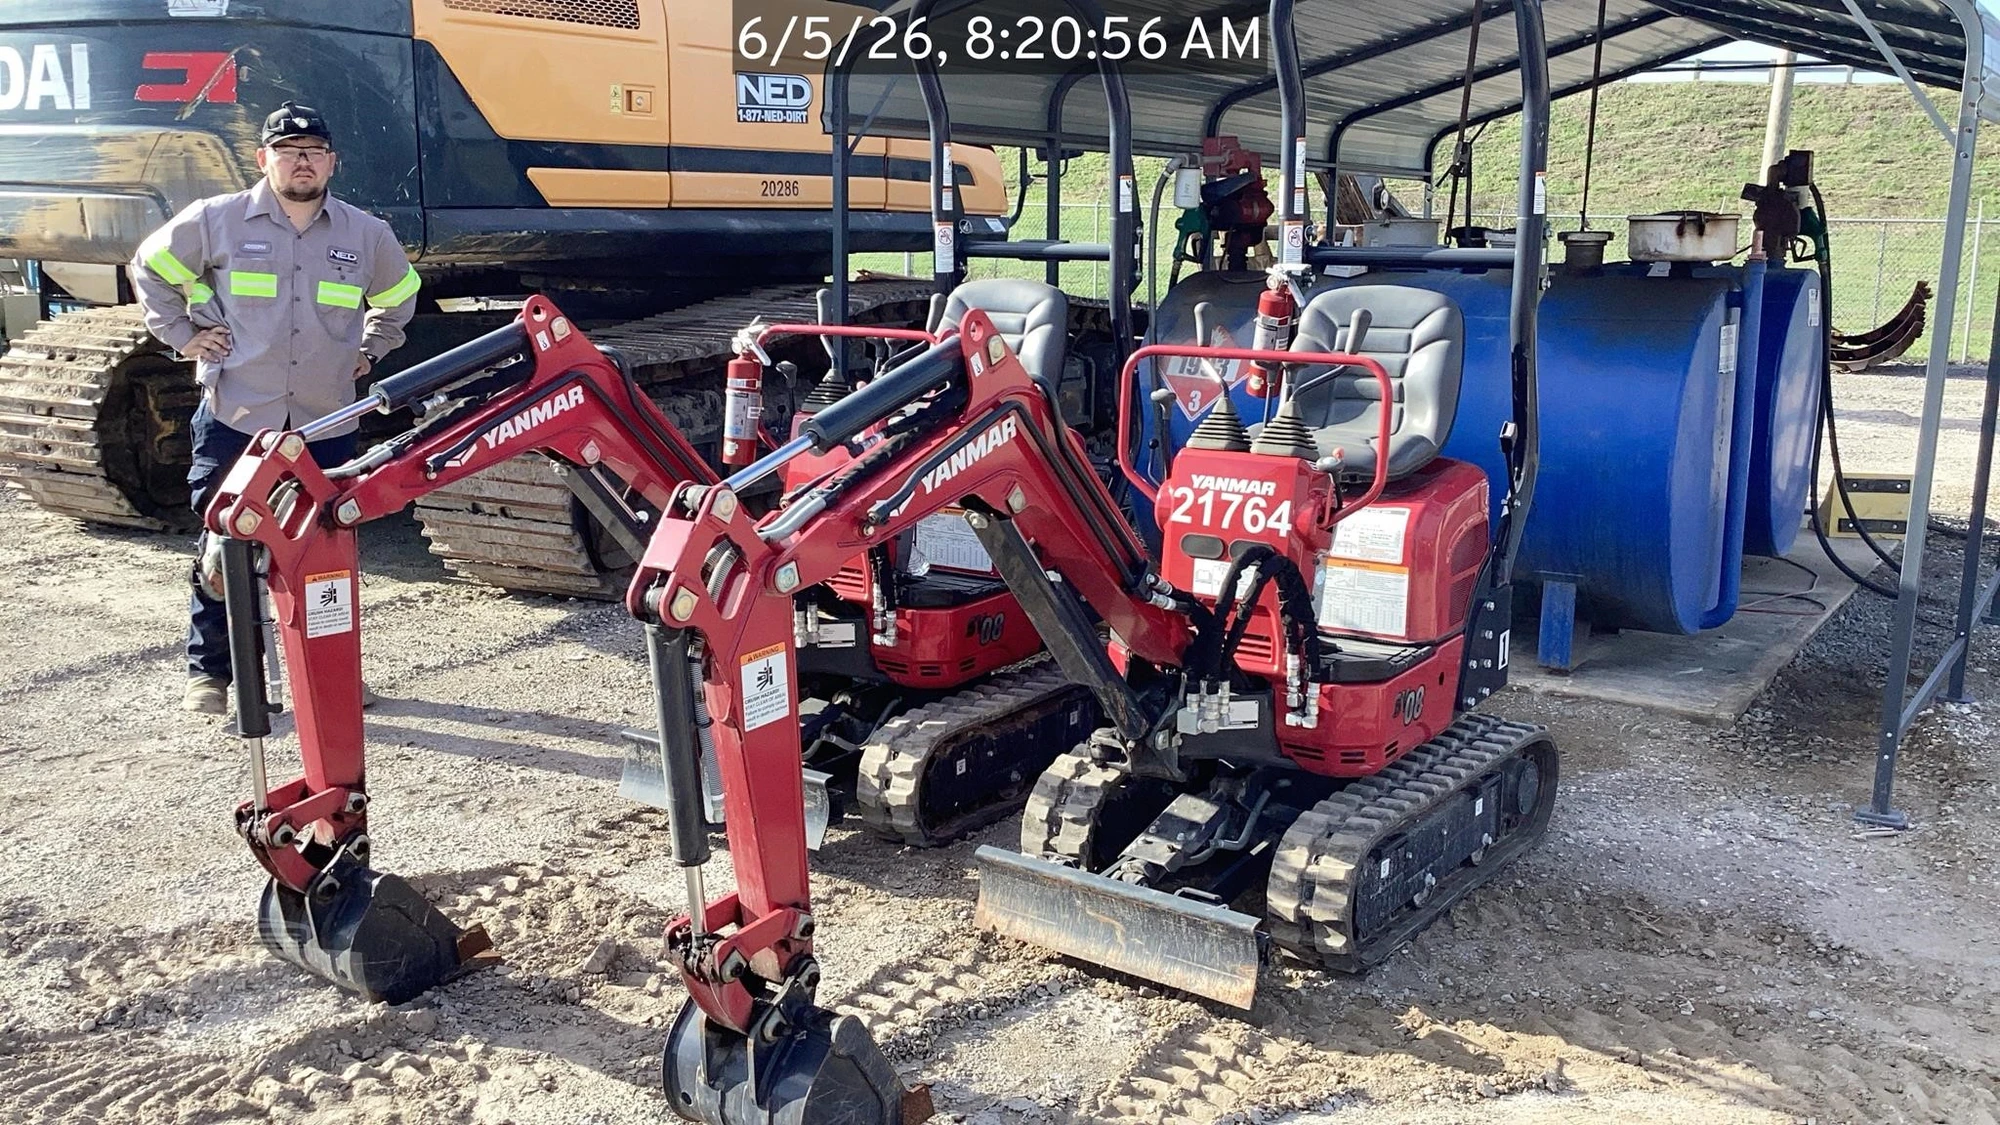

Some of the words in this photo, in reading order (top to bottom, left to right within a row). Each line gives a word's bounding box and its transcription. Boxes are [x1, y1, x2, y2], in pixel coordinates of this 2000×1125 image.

[737, 73, 812, 107] NED
[737, 108, 808, 123] 1-877-NED-DIRT
[761, 180, 799, 197] 20286
[330, 249, 358, 262] NED
[1178, 356, 1230, 379] 193
[1187, 390, 1202, 412] 3
[481, 385, 585, 449] YANMAR
[921, 415, 1017, 495] YANMAR
[1190, 474, 1277, 497] YANMAR
[1170, 486, 1293, 538] 21764
